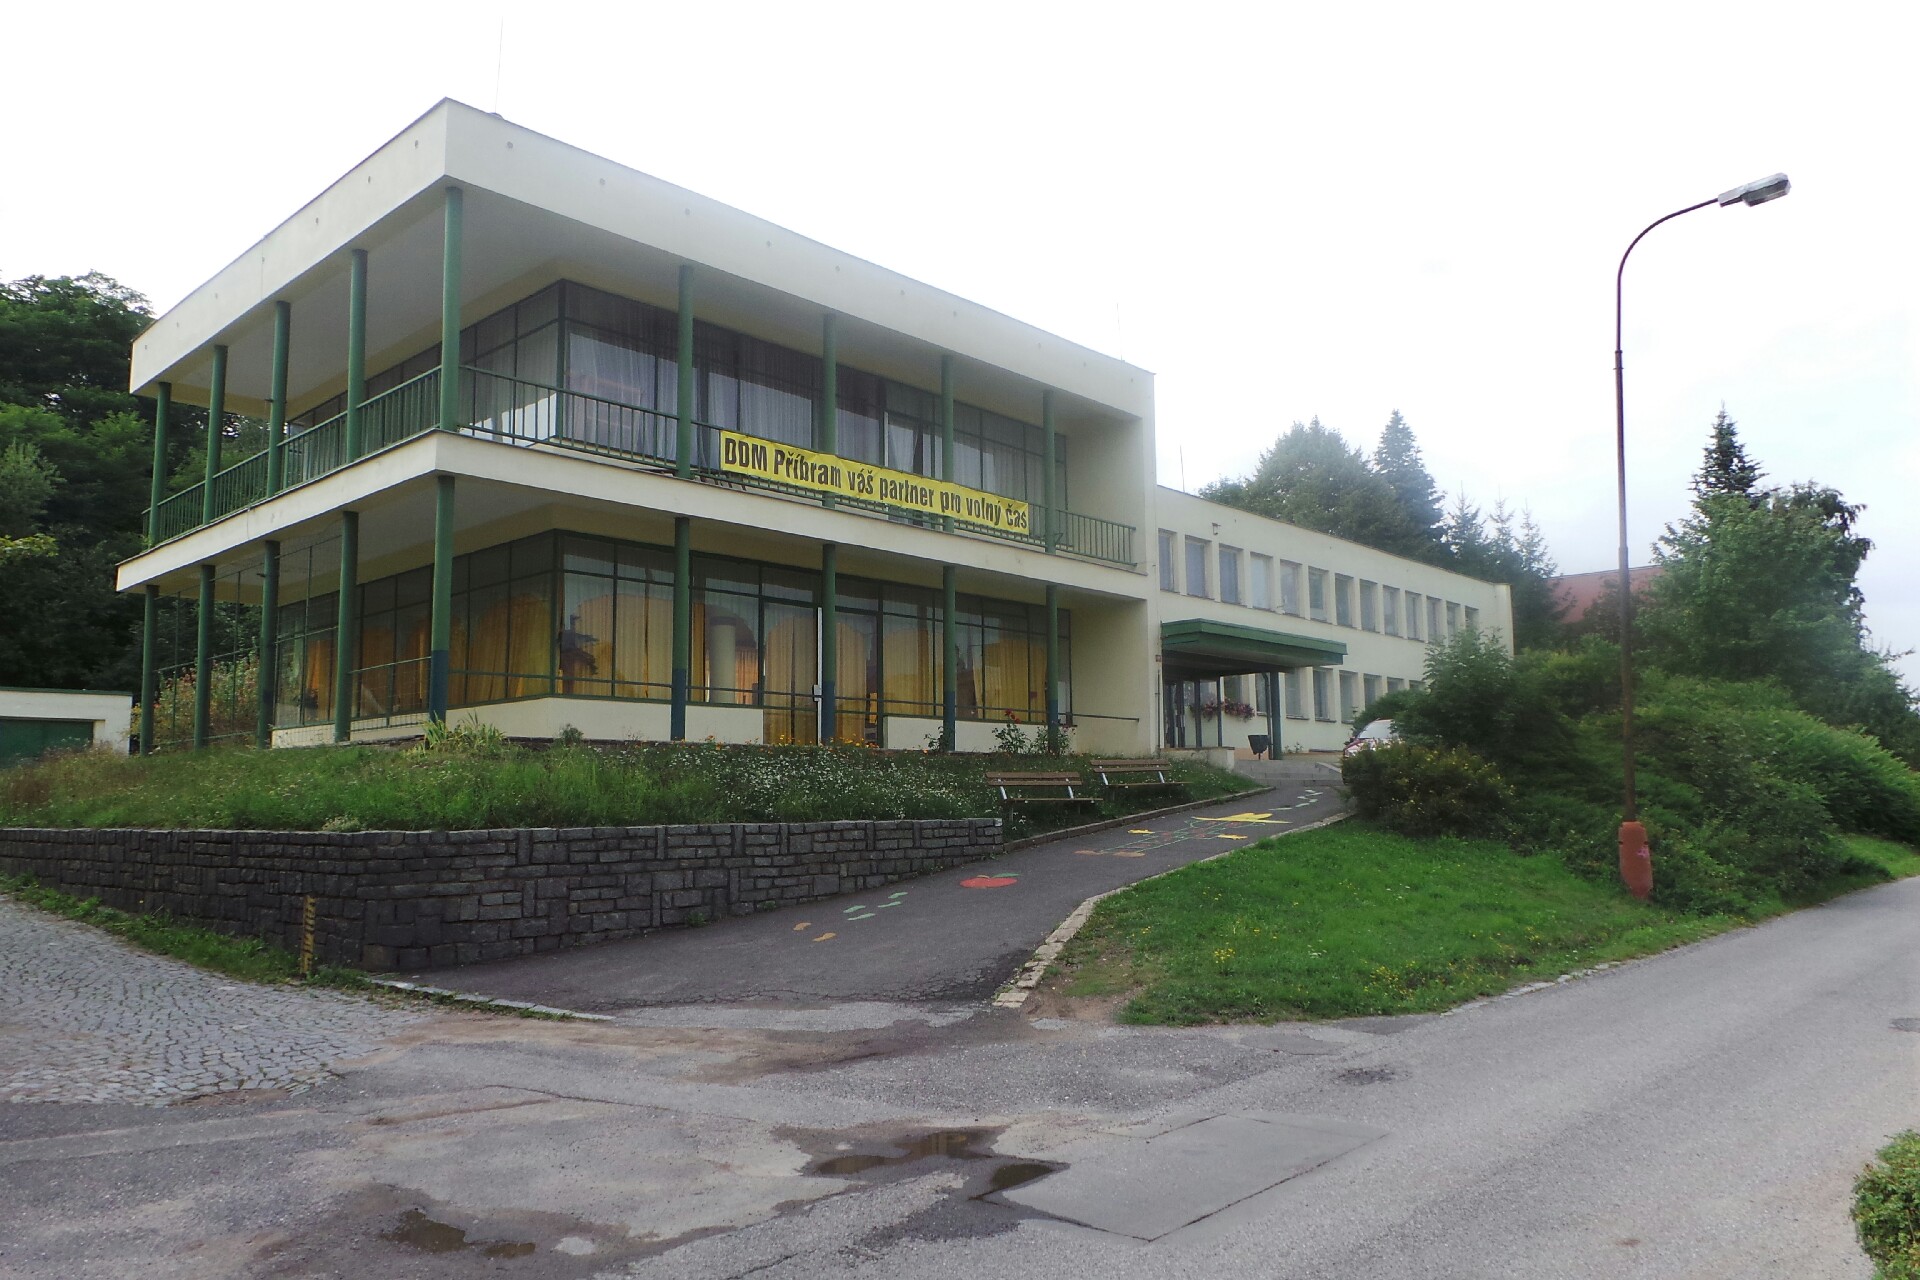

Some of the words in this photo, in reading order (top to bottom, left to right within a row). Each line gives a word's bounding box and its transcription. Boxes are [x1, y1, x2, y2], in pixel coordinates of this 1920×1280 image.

[724, 438, 768, 472] DDM
[773, 450, 842, 489] Příbram
[847, 468, 874, 495] váš
[879, 477, 935, 508] partner
[940, 490, 961, 513] pro
[965, 497, 1002, 526] volný
[1006, 503, 1028, 529] čas
